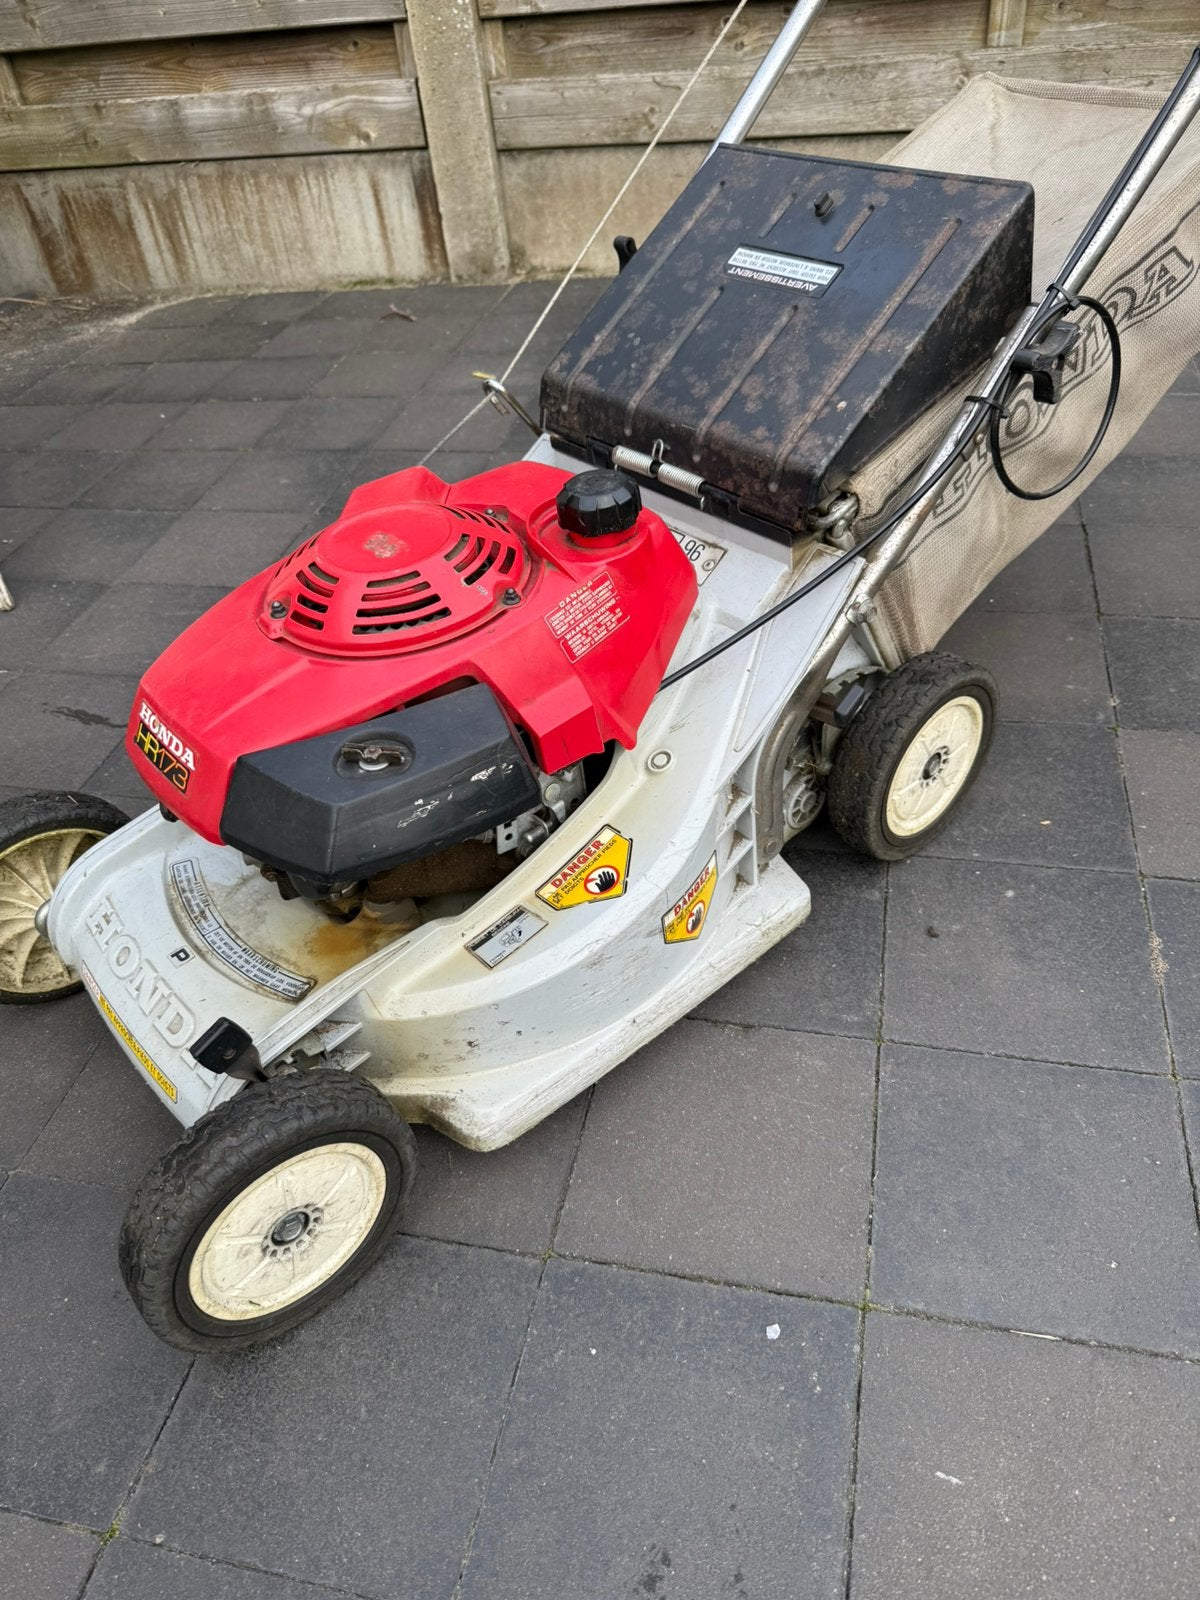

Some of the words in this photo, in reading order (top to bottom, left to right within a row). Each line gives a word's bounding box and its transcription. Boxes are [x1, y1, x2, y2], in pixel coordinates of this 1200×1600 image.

[728, 266, 818, 292] AVERTISSEMENT
[559, 580, 593, 608] DANGER
[564, 598, 617, 640] WAARSCHUWING
[136, 722, 189, 790] HR173
[139, 702, 196, 771] HONDA
[551, 839, 605, 889] DANGER
[560, 880, 572, 892] PAS
[570, 852, 602, 882] APPROCHER
[600, 838, 617, 854] PIEDS
[563, 875, 585, 895] DOIGTS
[674, 866, 710, 917] DANGER
[171, 947, 191, 962] P
